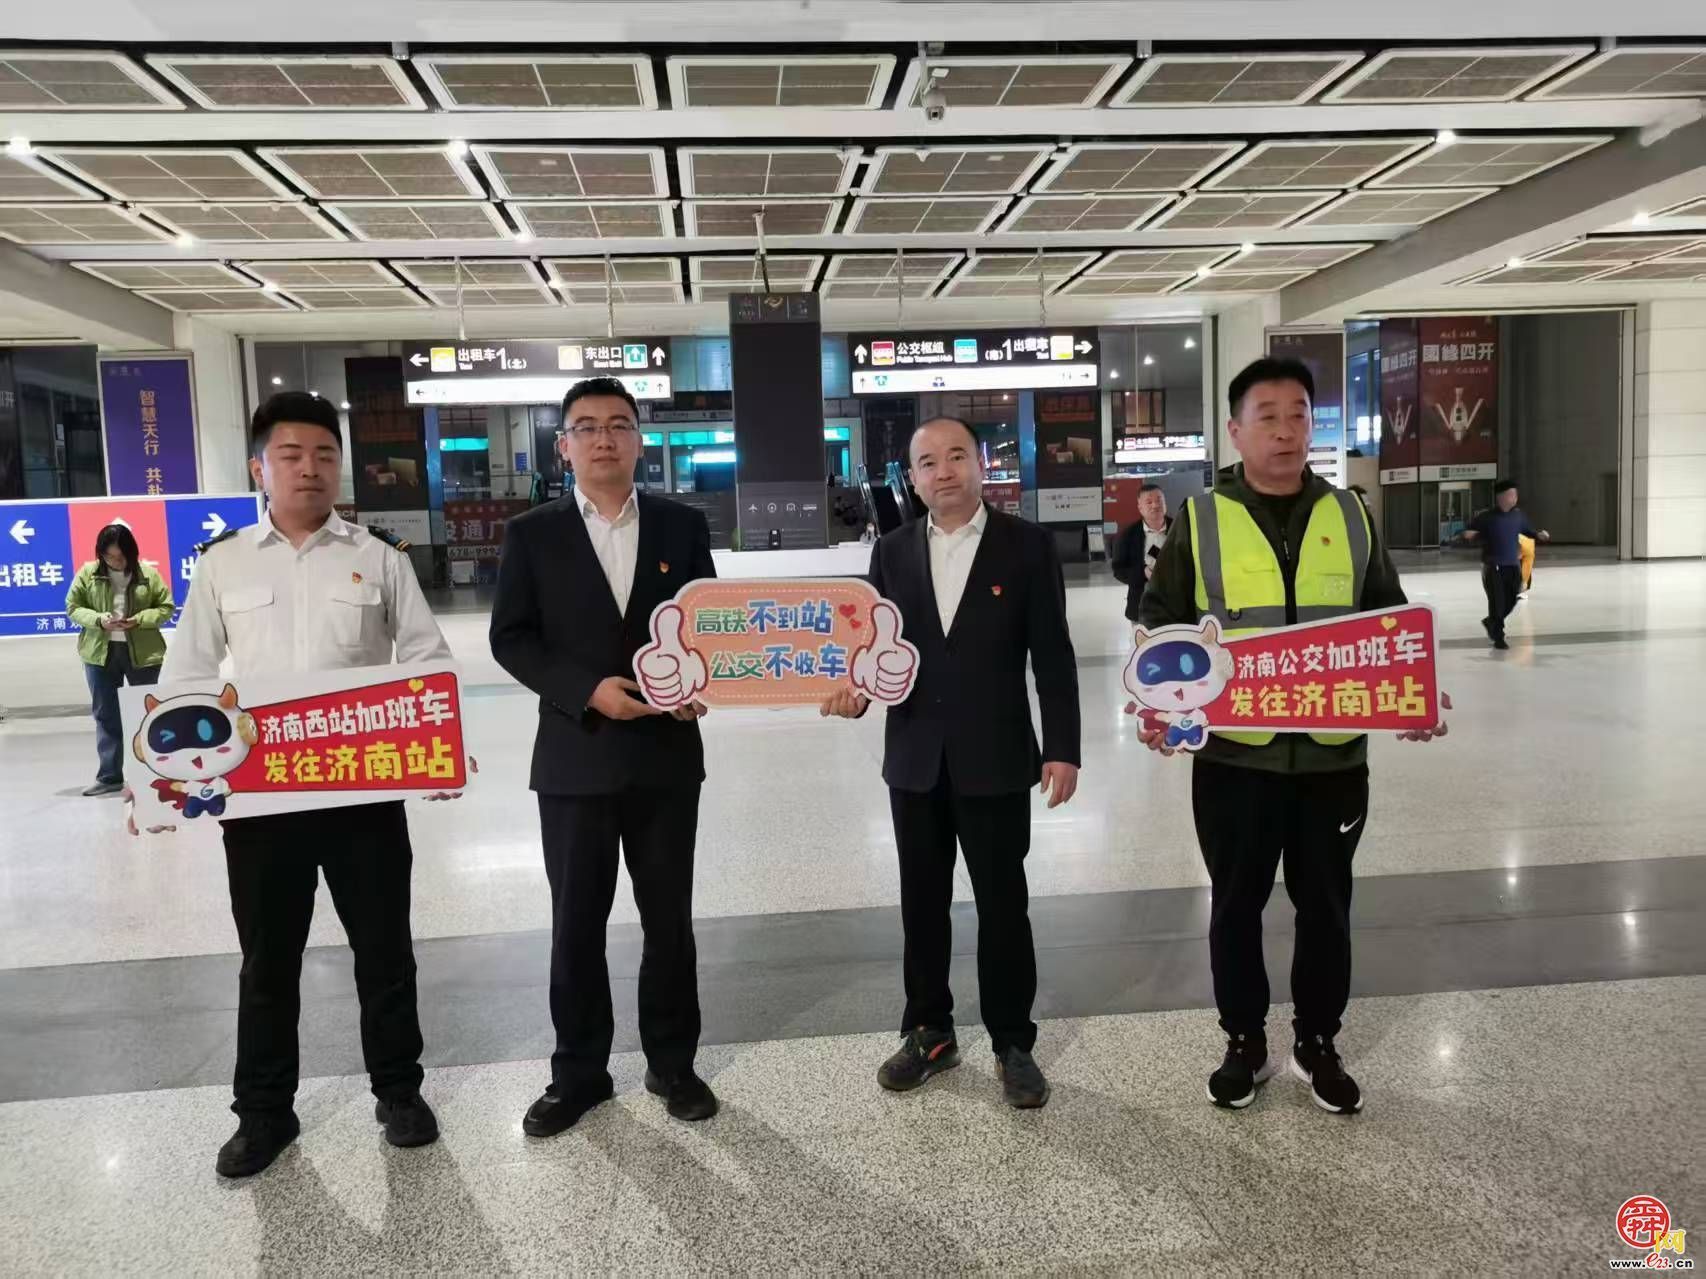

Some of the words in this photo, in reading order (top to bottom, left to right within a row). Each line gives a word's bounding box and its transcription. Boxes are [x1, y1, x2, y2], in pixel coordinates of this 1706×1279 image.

[584, 346, 622, 360] 东出口
[139, 389, 160, 456] 智慧天行
[696, 600, 833, 635] 高铁不到站
[711, 643, 848, 680] 公交不收车
[1238, 630, 1427, 679] 济南公交加班车
[261, 689, 454, 745] 济南西站加班车
[1230, 676, 1427, 718] 发往济南站
[264, 737, 455, 783] 发往济南站
